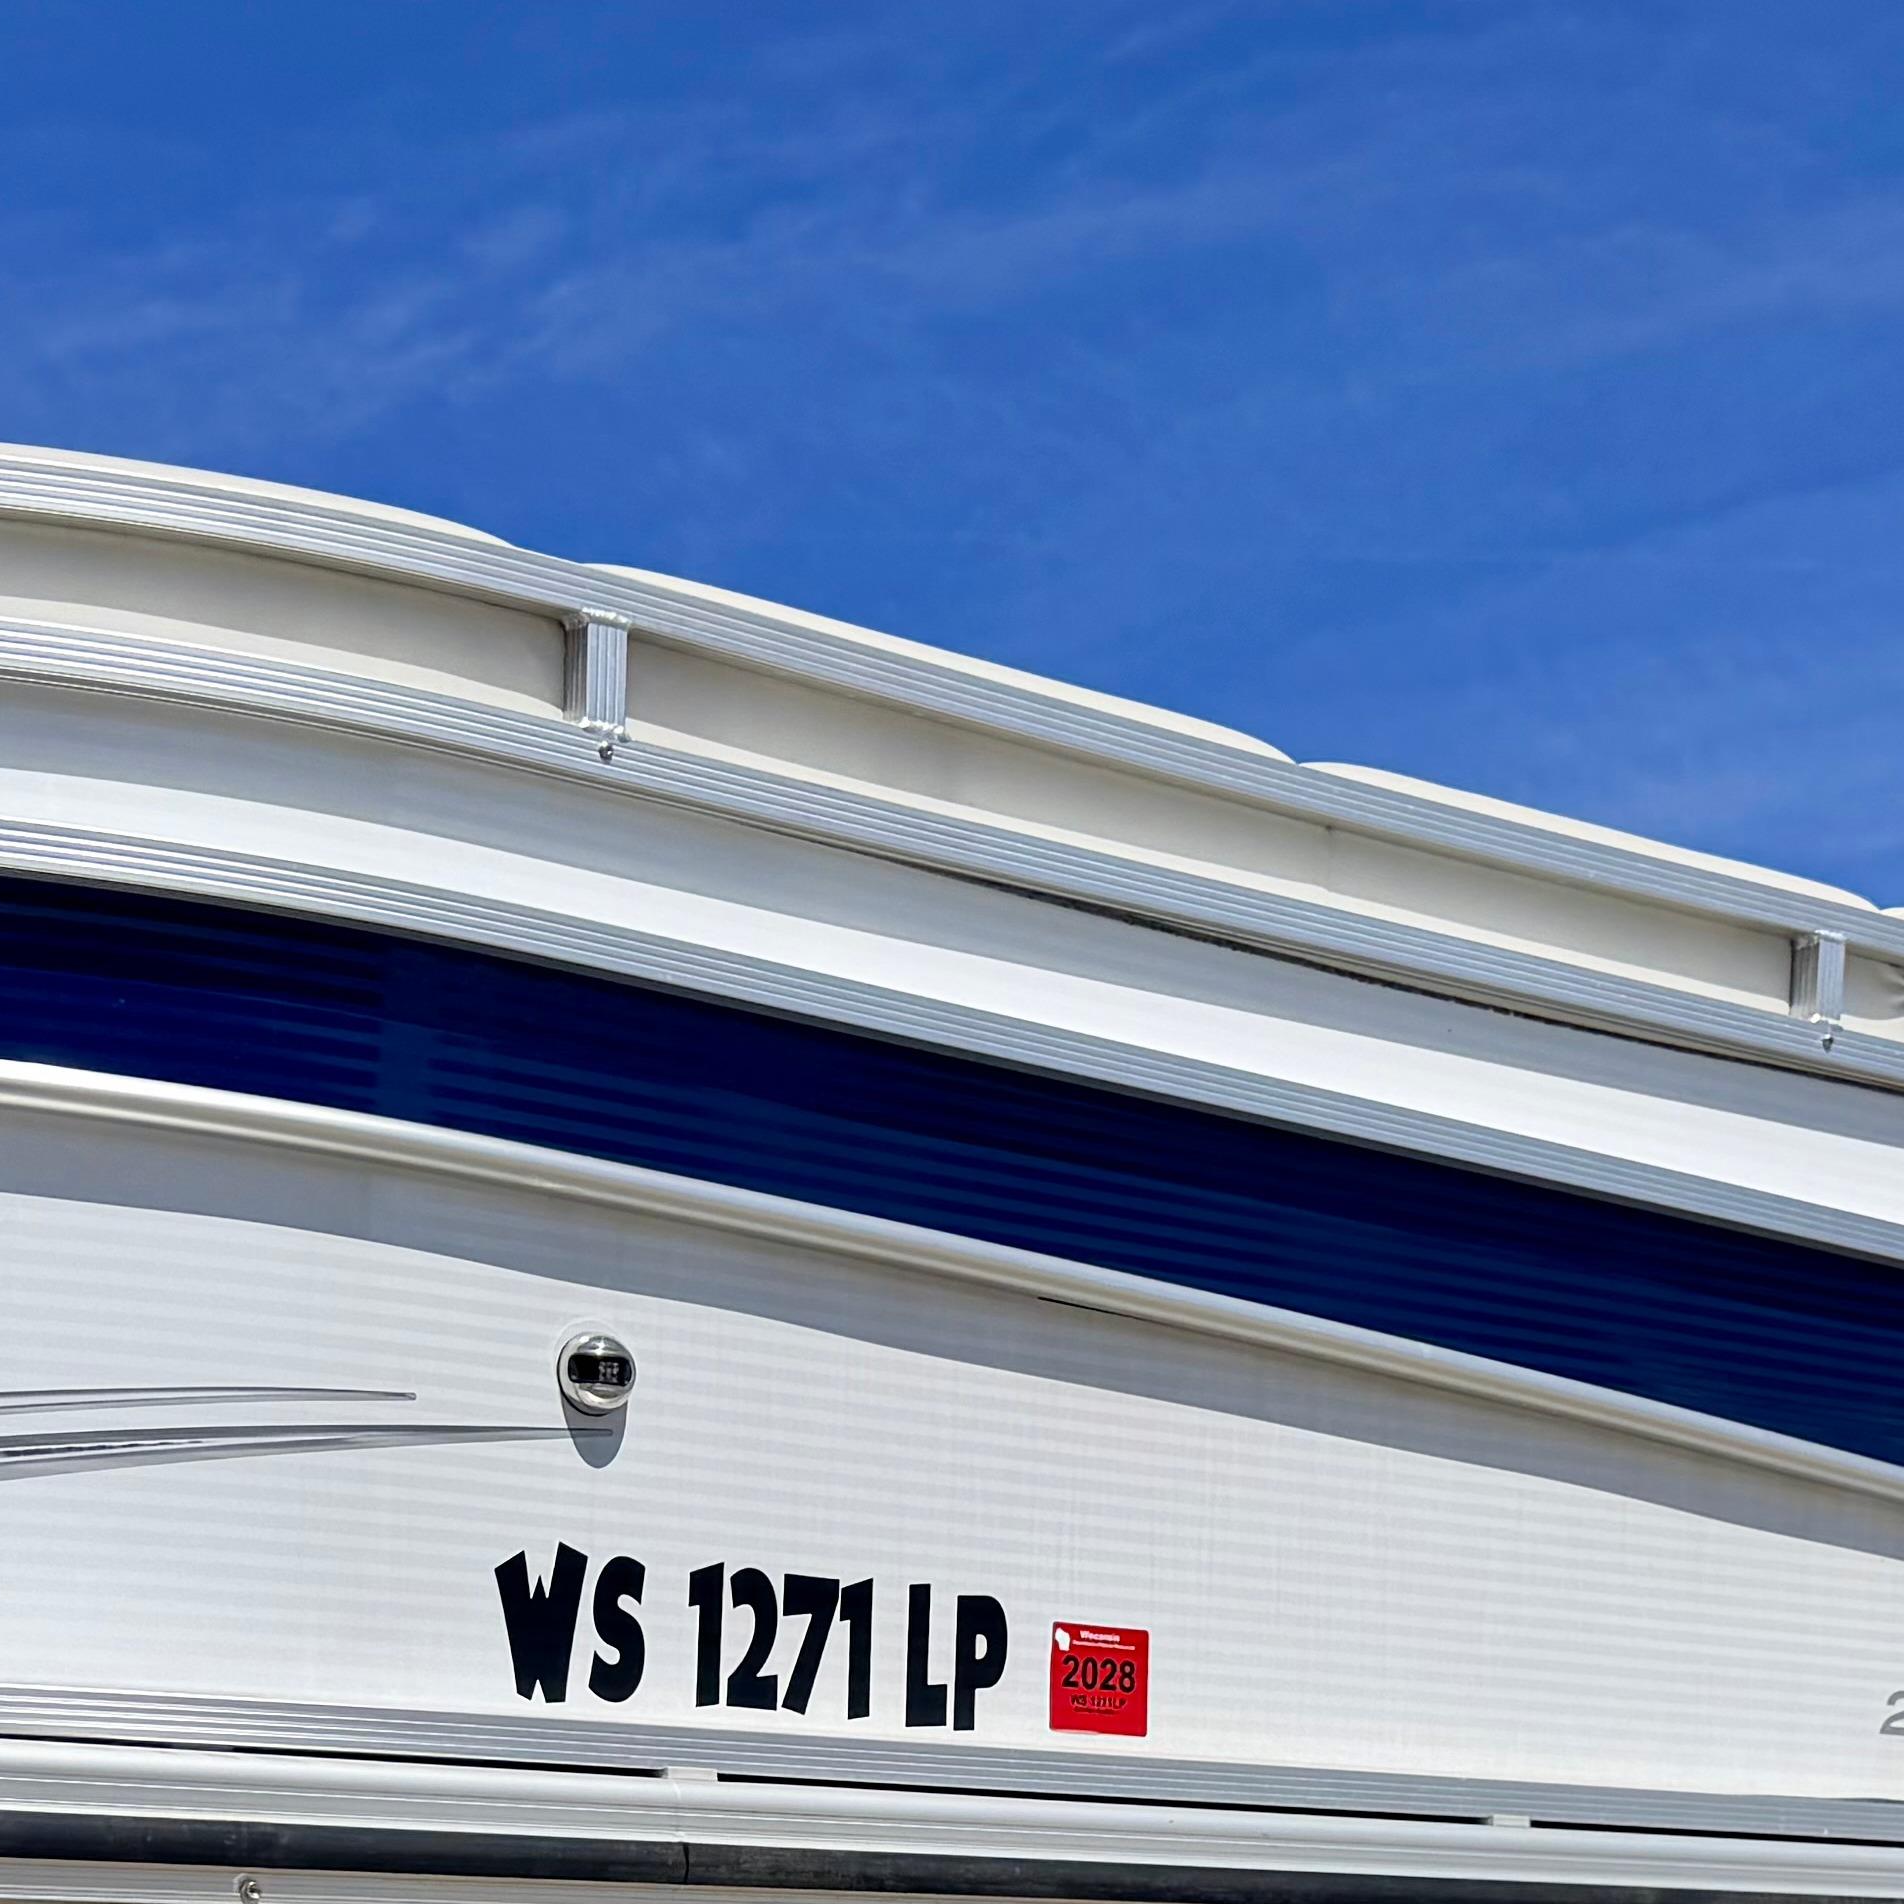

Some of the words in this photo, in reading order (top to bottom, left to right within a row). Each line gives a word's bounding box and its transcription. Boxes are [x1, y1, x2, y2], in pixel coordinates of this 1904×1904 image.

[494, 1541, 646, 1703] WS
[689, 1562, 874, 1719] 1271
[905, 1583, 1008, 1731] LP
[1063, 1654, 1136, 1693] 2028
